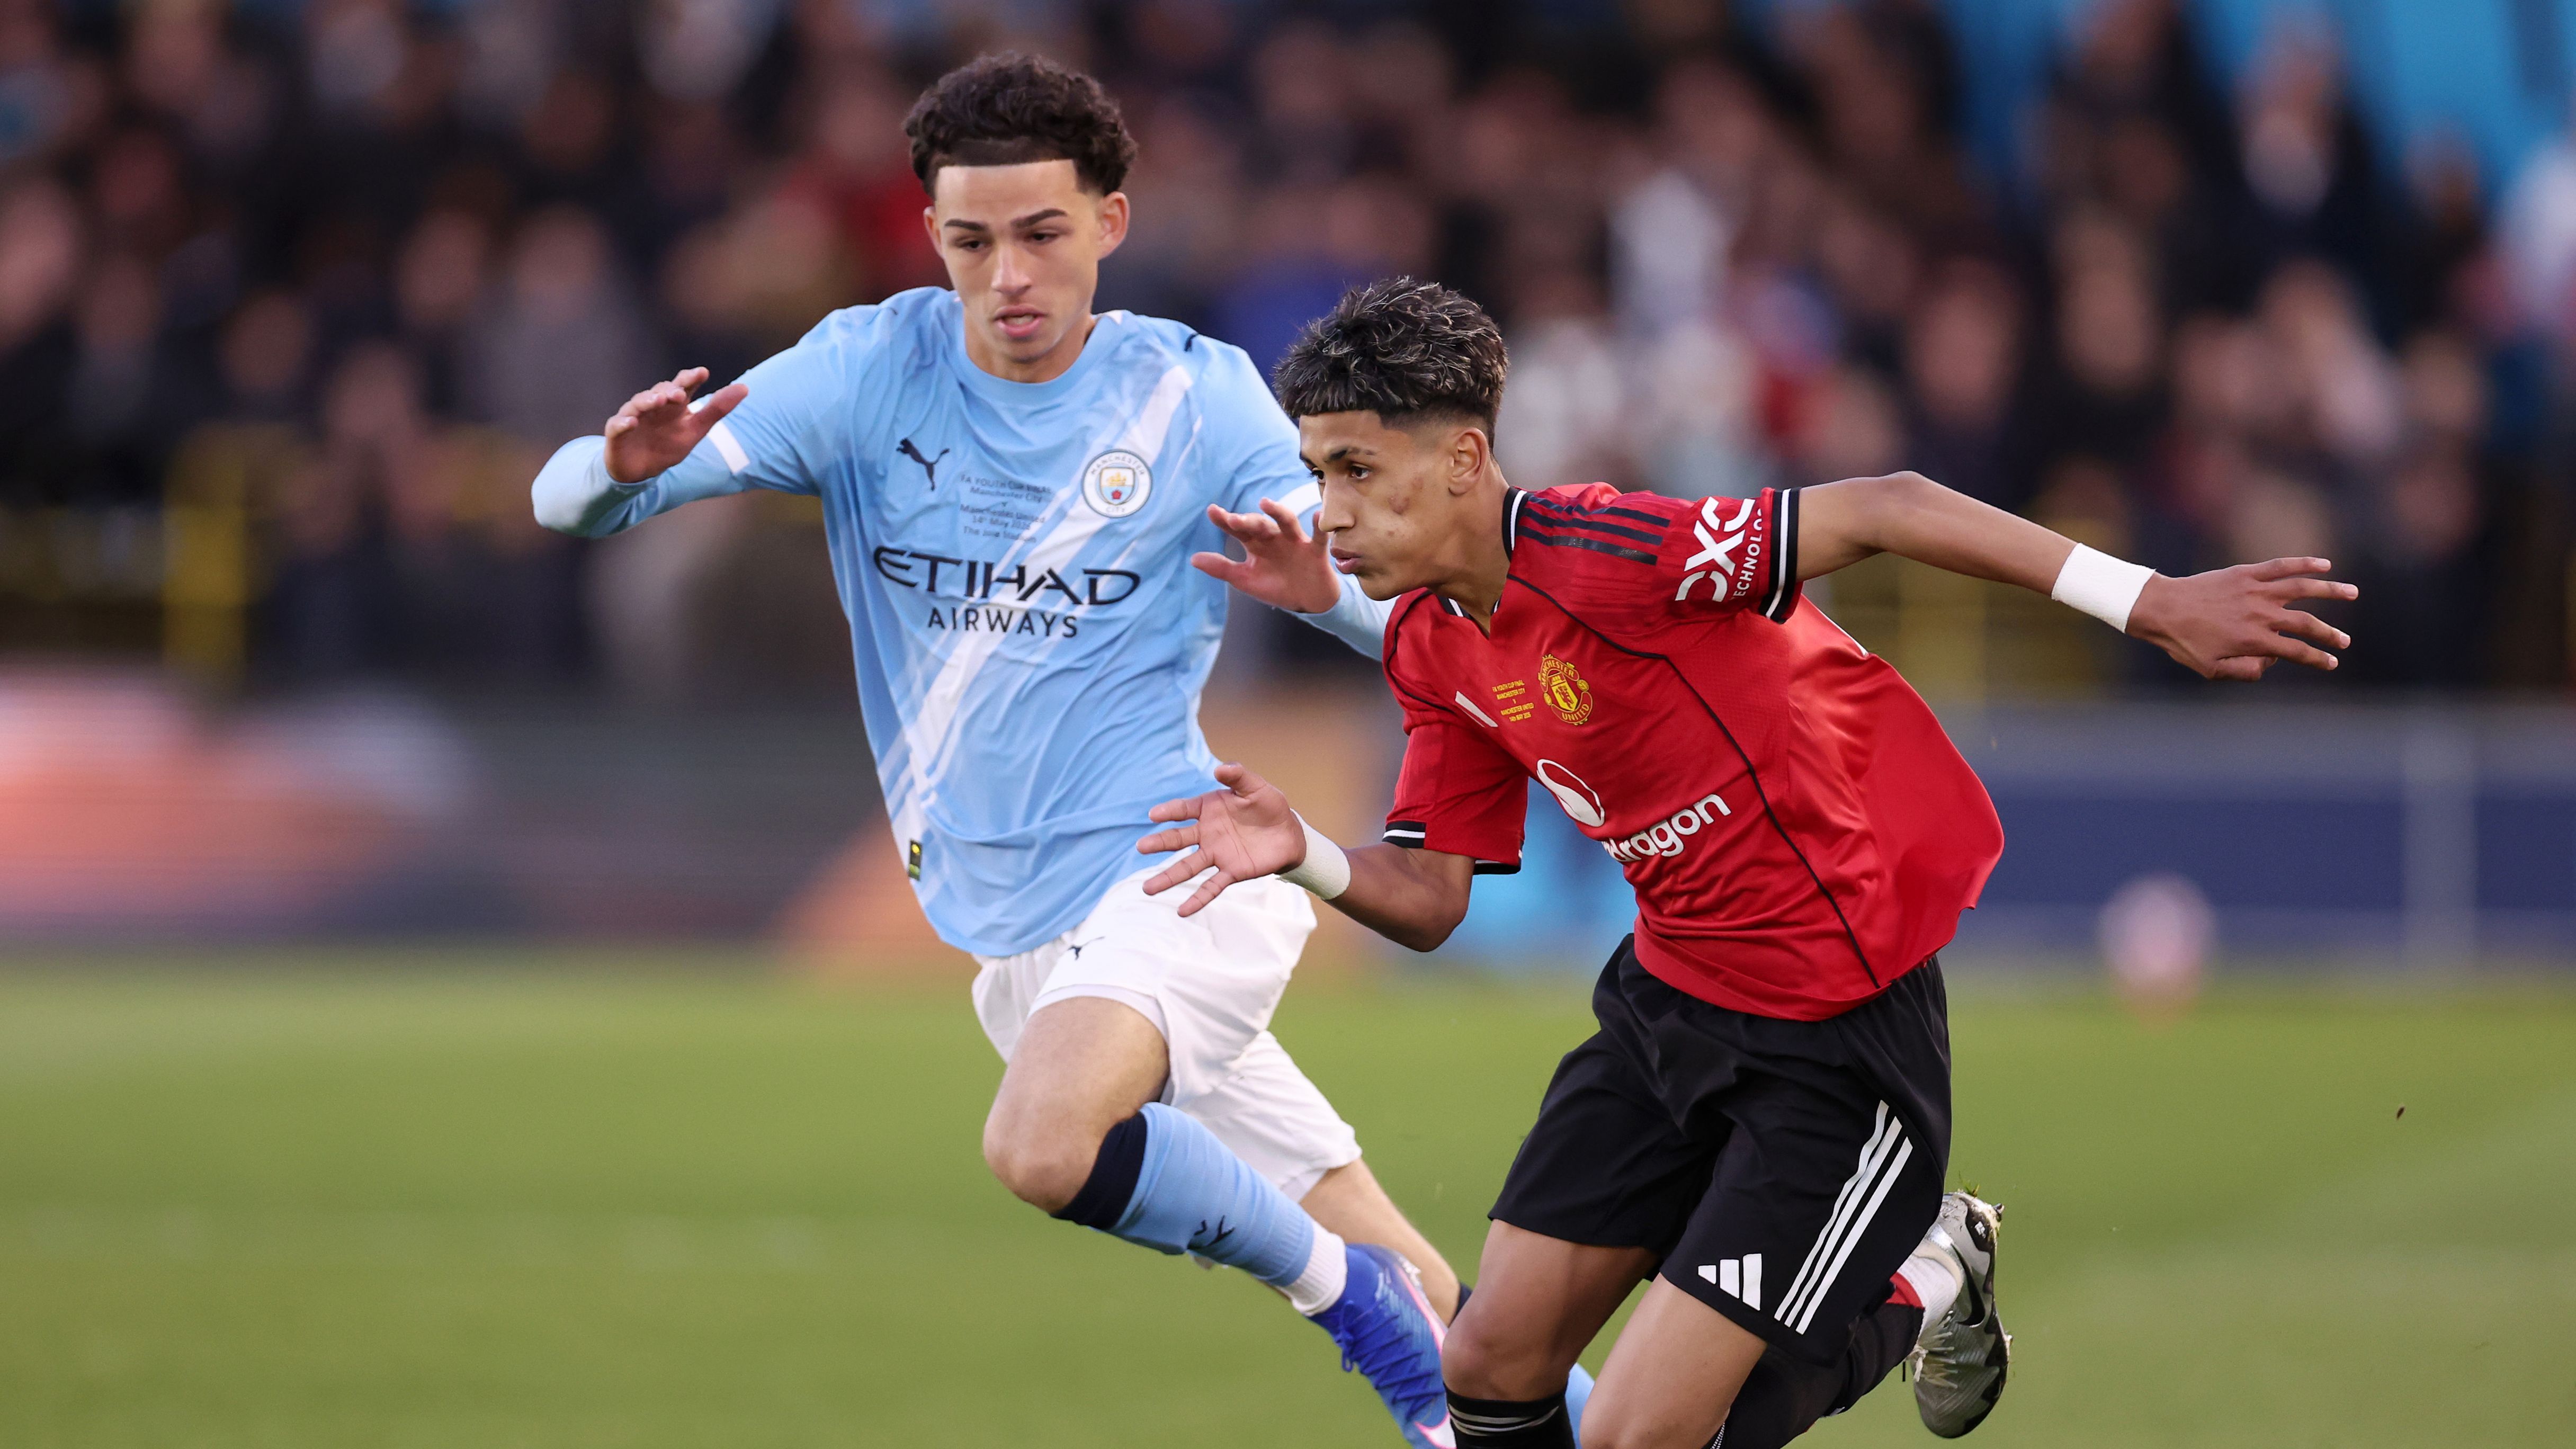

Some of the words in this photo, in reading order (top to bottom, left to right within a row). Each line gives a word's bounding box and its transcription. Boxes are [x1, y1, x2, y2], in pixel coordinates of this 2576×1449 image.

[1090, 455, 1145, 475] MANCHESTER
[874, 546, 1141, 605] ETIHAD
[928, 606, 1078, 638] AIRWAYS
[1541, 659, 1575, 687] MANCHESTER
[1562, 704, 1589, 721] UNITED
